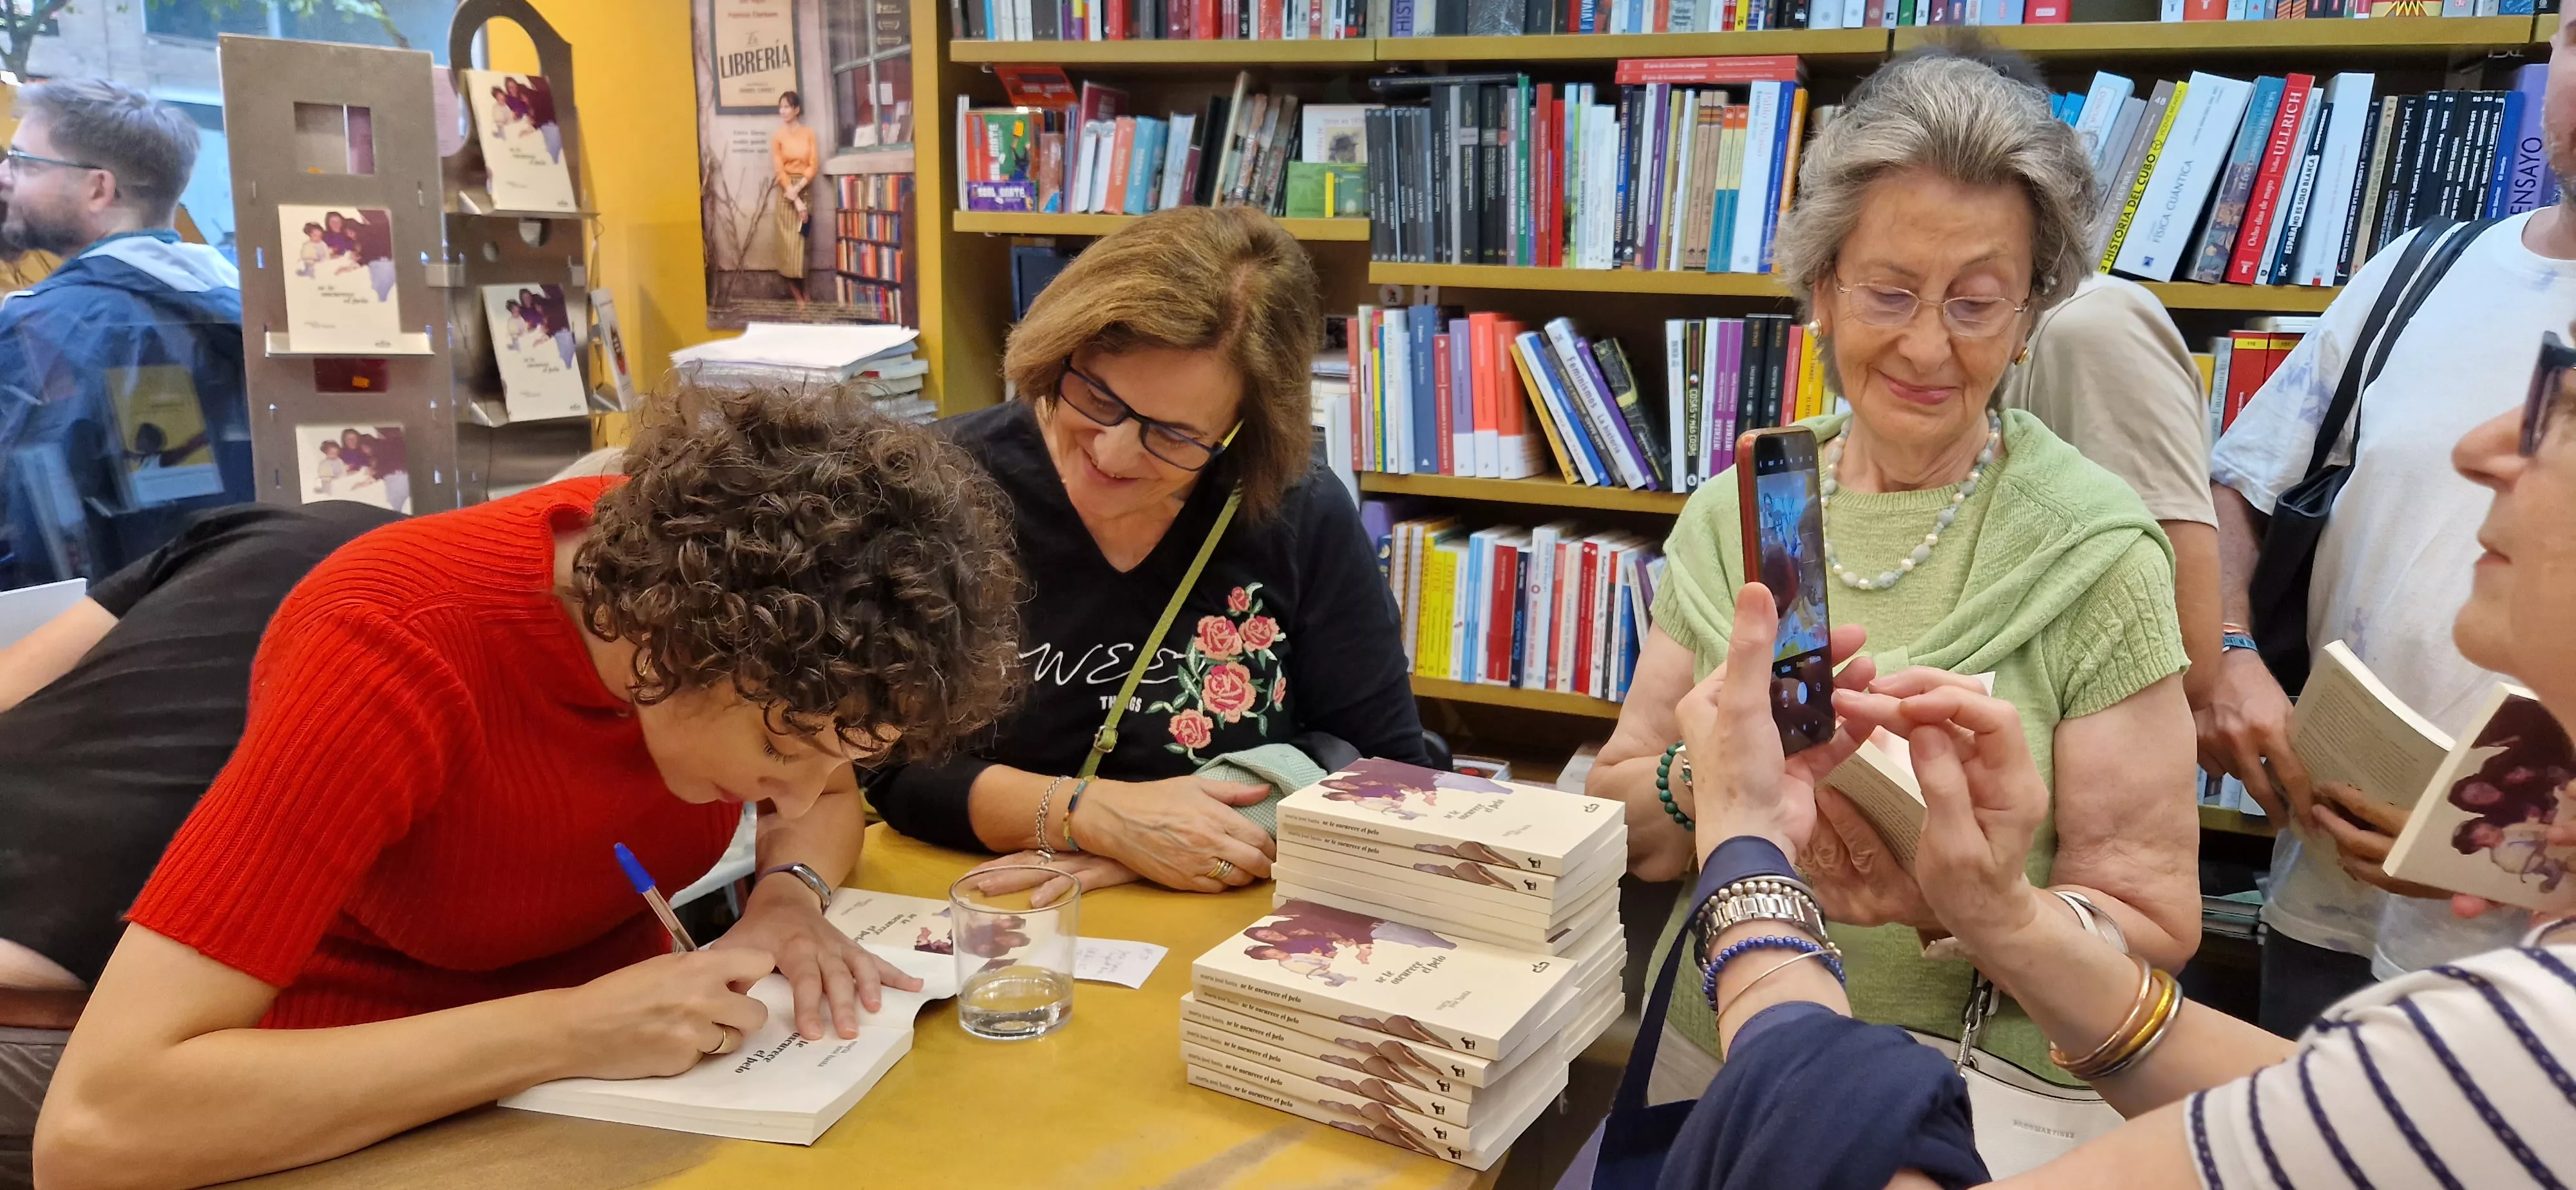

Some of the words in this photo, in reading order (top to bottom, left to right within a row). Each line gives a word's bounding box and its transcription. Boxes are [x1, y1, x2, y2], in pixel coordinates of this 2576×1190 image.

[720, 39, 791, 79] LIBRERÍA
[2154, 97, 2166, 106] 48
[2274, 91, 2302, 156] ULLRICH
[2301, 158, 2316, 186] BLANCA
[2510, 137, 2543, 215] ENSAYO
[2166, 160, 2193, 212] CUÁNTICA
[2262, 180, 2275, 199] mayo
[2259, 201, 2268, 210] de
[2297, 188, 2308, 205] SOLO
[2103, 211, 2132, 263] HISTORIA
[2129, 185, 2141, 208] DEL
[2137, 154, 2155, 185] CUBO
[2253, 211, 2266, 226] días
[2291, 216, 2300, 226] NO
[2247, 227, 2260, 247] Ocho
[2284, 227, 2298, 254] ESPAÑA
[1566, 355, 1598, 409] Feminismos
[1689, 388, 1698, 413] COSAS
[1596, 414, 1609, 429] La
[1688, 420, 1696, 433] MÁS
[1602, 424, 1621, 453] historia
[1713, 419, 1723, 450] INTENSAS
[1725, 419, 1734, 451] INTENSAS
[1687, 435, 1696, 456] COSAS
[1444, 564, 1455, 595] DYER
[1367, 846, 1379, 855] pelo
[1428, 955, 1446, 969] pelo
[1375, 976, 1386, 984] se
[1390, 960, 1423, 985] oscurece
[1287, 995, 1302, 1003] pelo
[1287, 1015, 1300, 1025] pelo
[1271, 1032, 1284, 1041] pelo
[753, 1050, 765, 1058] el
[763, 1032, 800, 1062] oscurece
[735, 1057, 758, 1073] pelo
[1269, 1054, 1281, 1062] pelo
[1270, 1077, 1283, 1086] pelo
[1280, 1099, 1293, 1108] pelo
